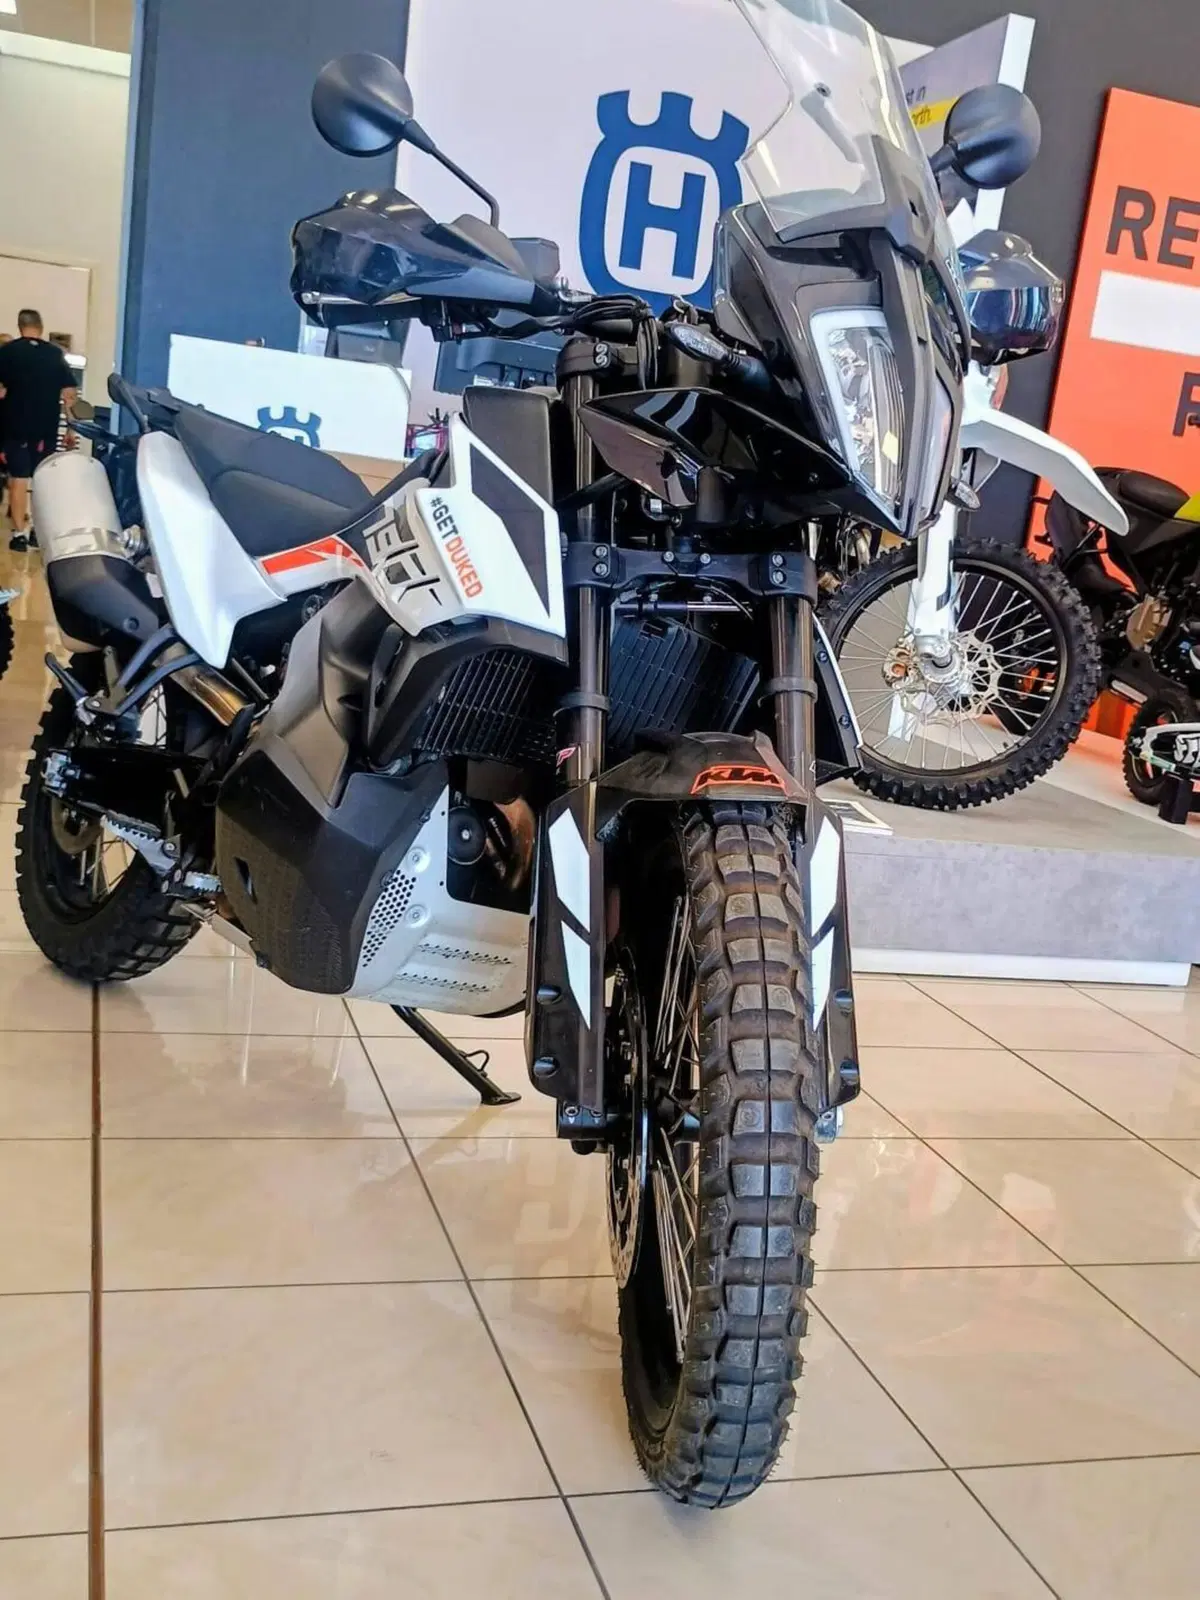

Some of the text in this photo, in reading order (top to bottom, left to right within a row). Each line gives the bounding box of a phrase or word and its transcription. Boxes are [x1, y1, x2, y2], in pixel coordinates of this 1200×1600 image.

[619, 161, 706, 280] H
[1106, 185, 1200, 268] RE
[430, 496, 483, 598] #GETDUKED
